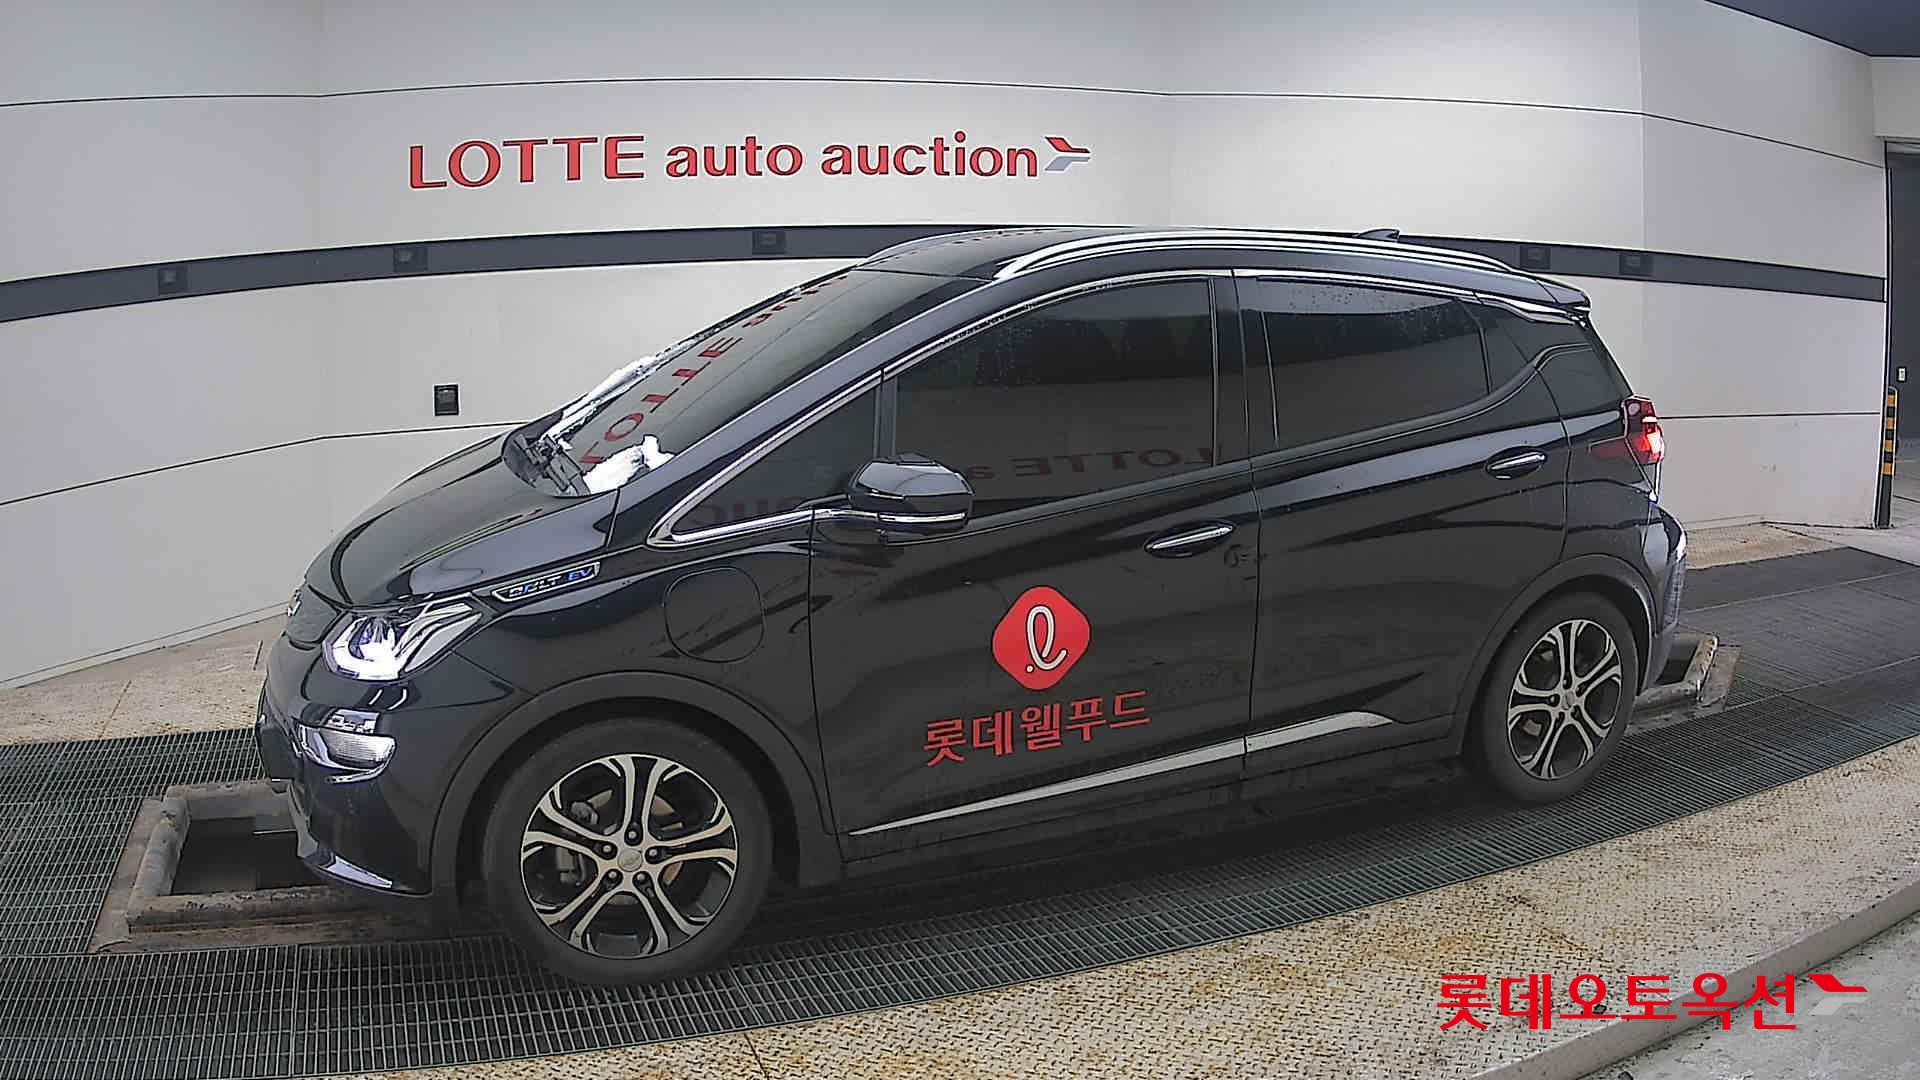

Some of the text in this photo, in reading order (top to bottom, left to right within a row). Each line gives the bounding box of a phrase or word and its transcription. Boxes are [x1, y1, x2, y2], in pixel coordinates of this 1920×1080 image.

[409, 131, 1038, 188] LOTTE auto auction
[924, 690, 1151, 767] 롯데웰푸드
